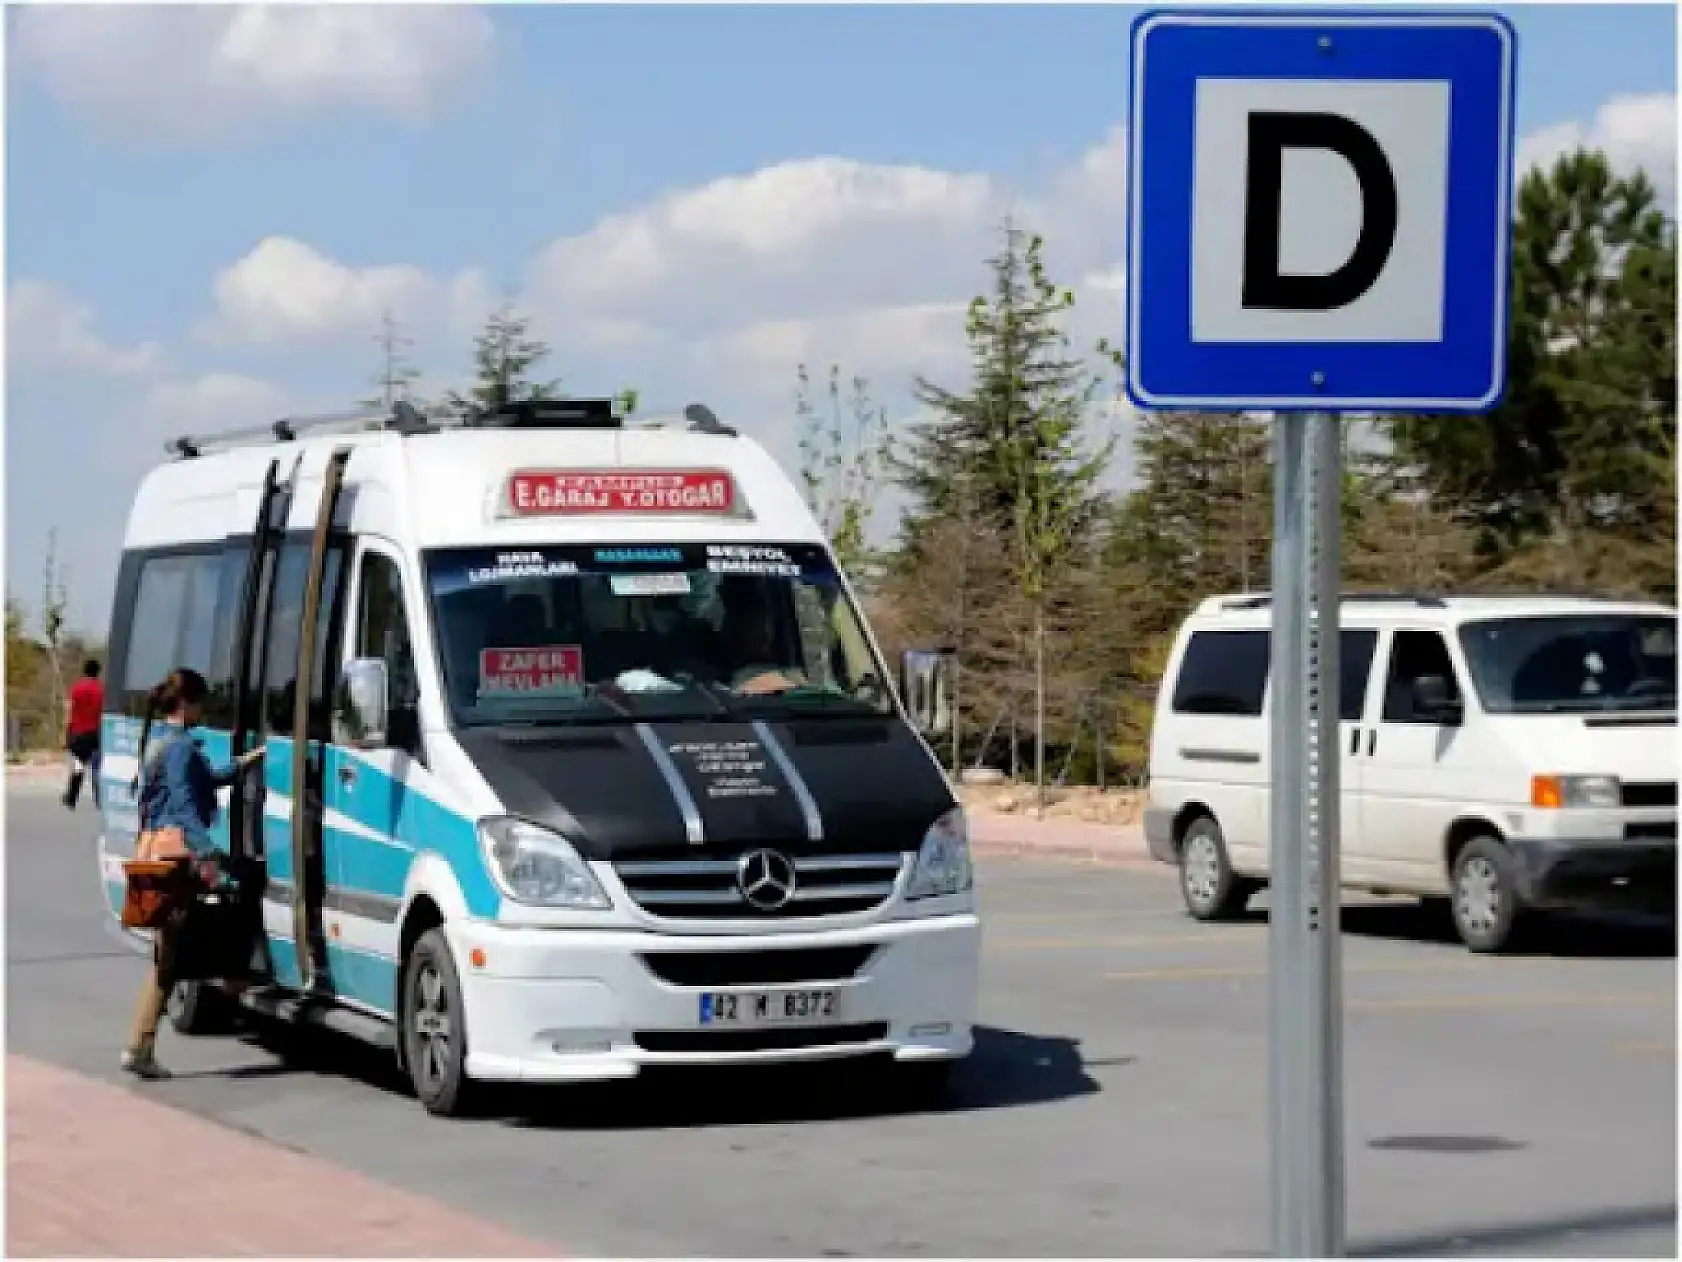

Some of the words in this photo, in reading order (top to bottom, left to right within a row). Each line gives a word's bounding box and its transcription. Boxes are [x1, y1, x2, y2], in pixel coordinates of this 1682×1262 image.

[1241, 111, 1398, 309] D
[515, 480, 608, 506] E.GARAJ
[620, 480, 725, 506] Y.OTOGAR
[499, 652, 566, 670] ZAFER
[713, 995, 737, 1019] 42
